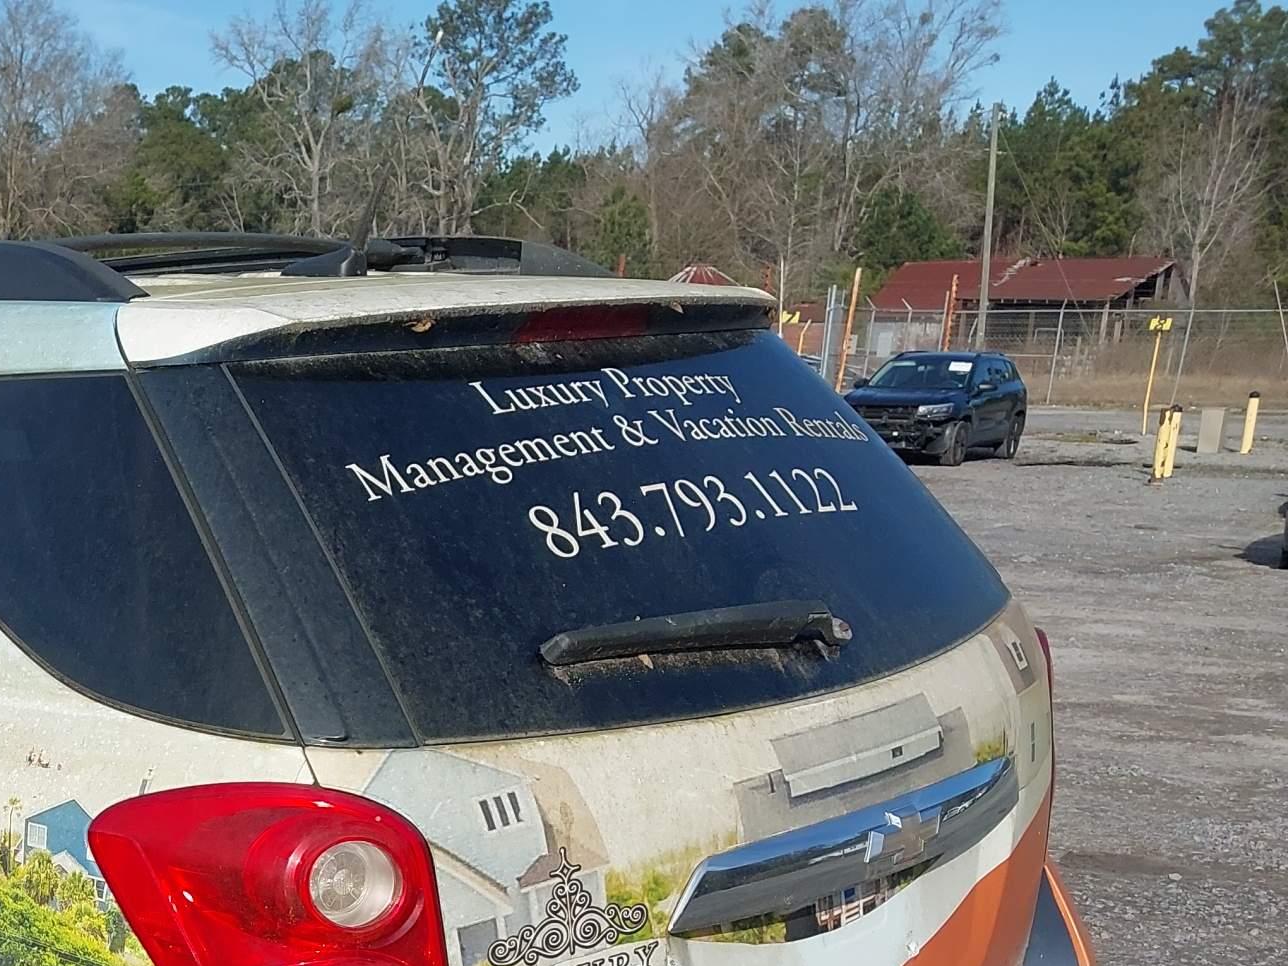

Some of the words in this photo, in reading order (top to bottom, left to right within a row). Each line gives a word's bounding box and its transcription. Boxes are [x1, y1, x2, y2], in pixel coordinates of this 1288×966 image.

[469, 379, 609, 415] Luxury
[601, 367, 742, 406] Property
[345, 426, 616, 502] Management
[613, 415, 659, 447] &
[647, 408, 788, 442] Vacation
[773, 407, 870, 443] Rentals
[528, 466, 858, 558] 843.793.1122
